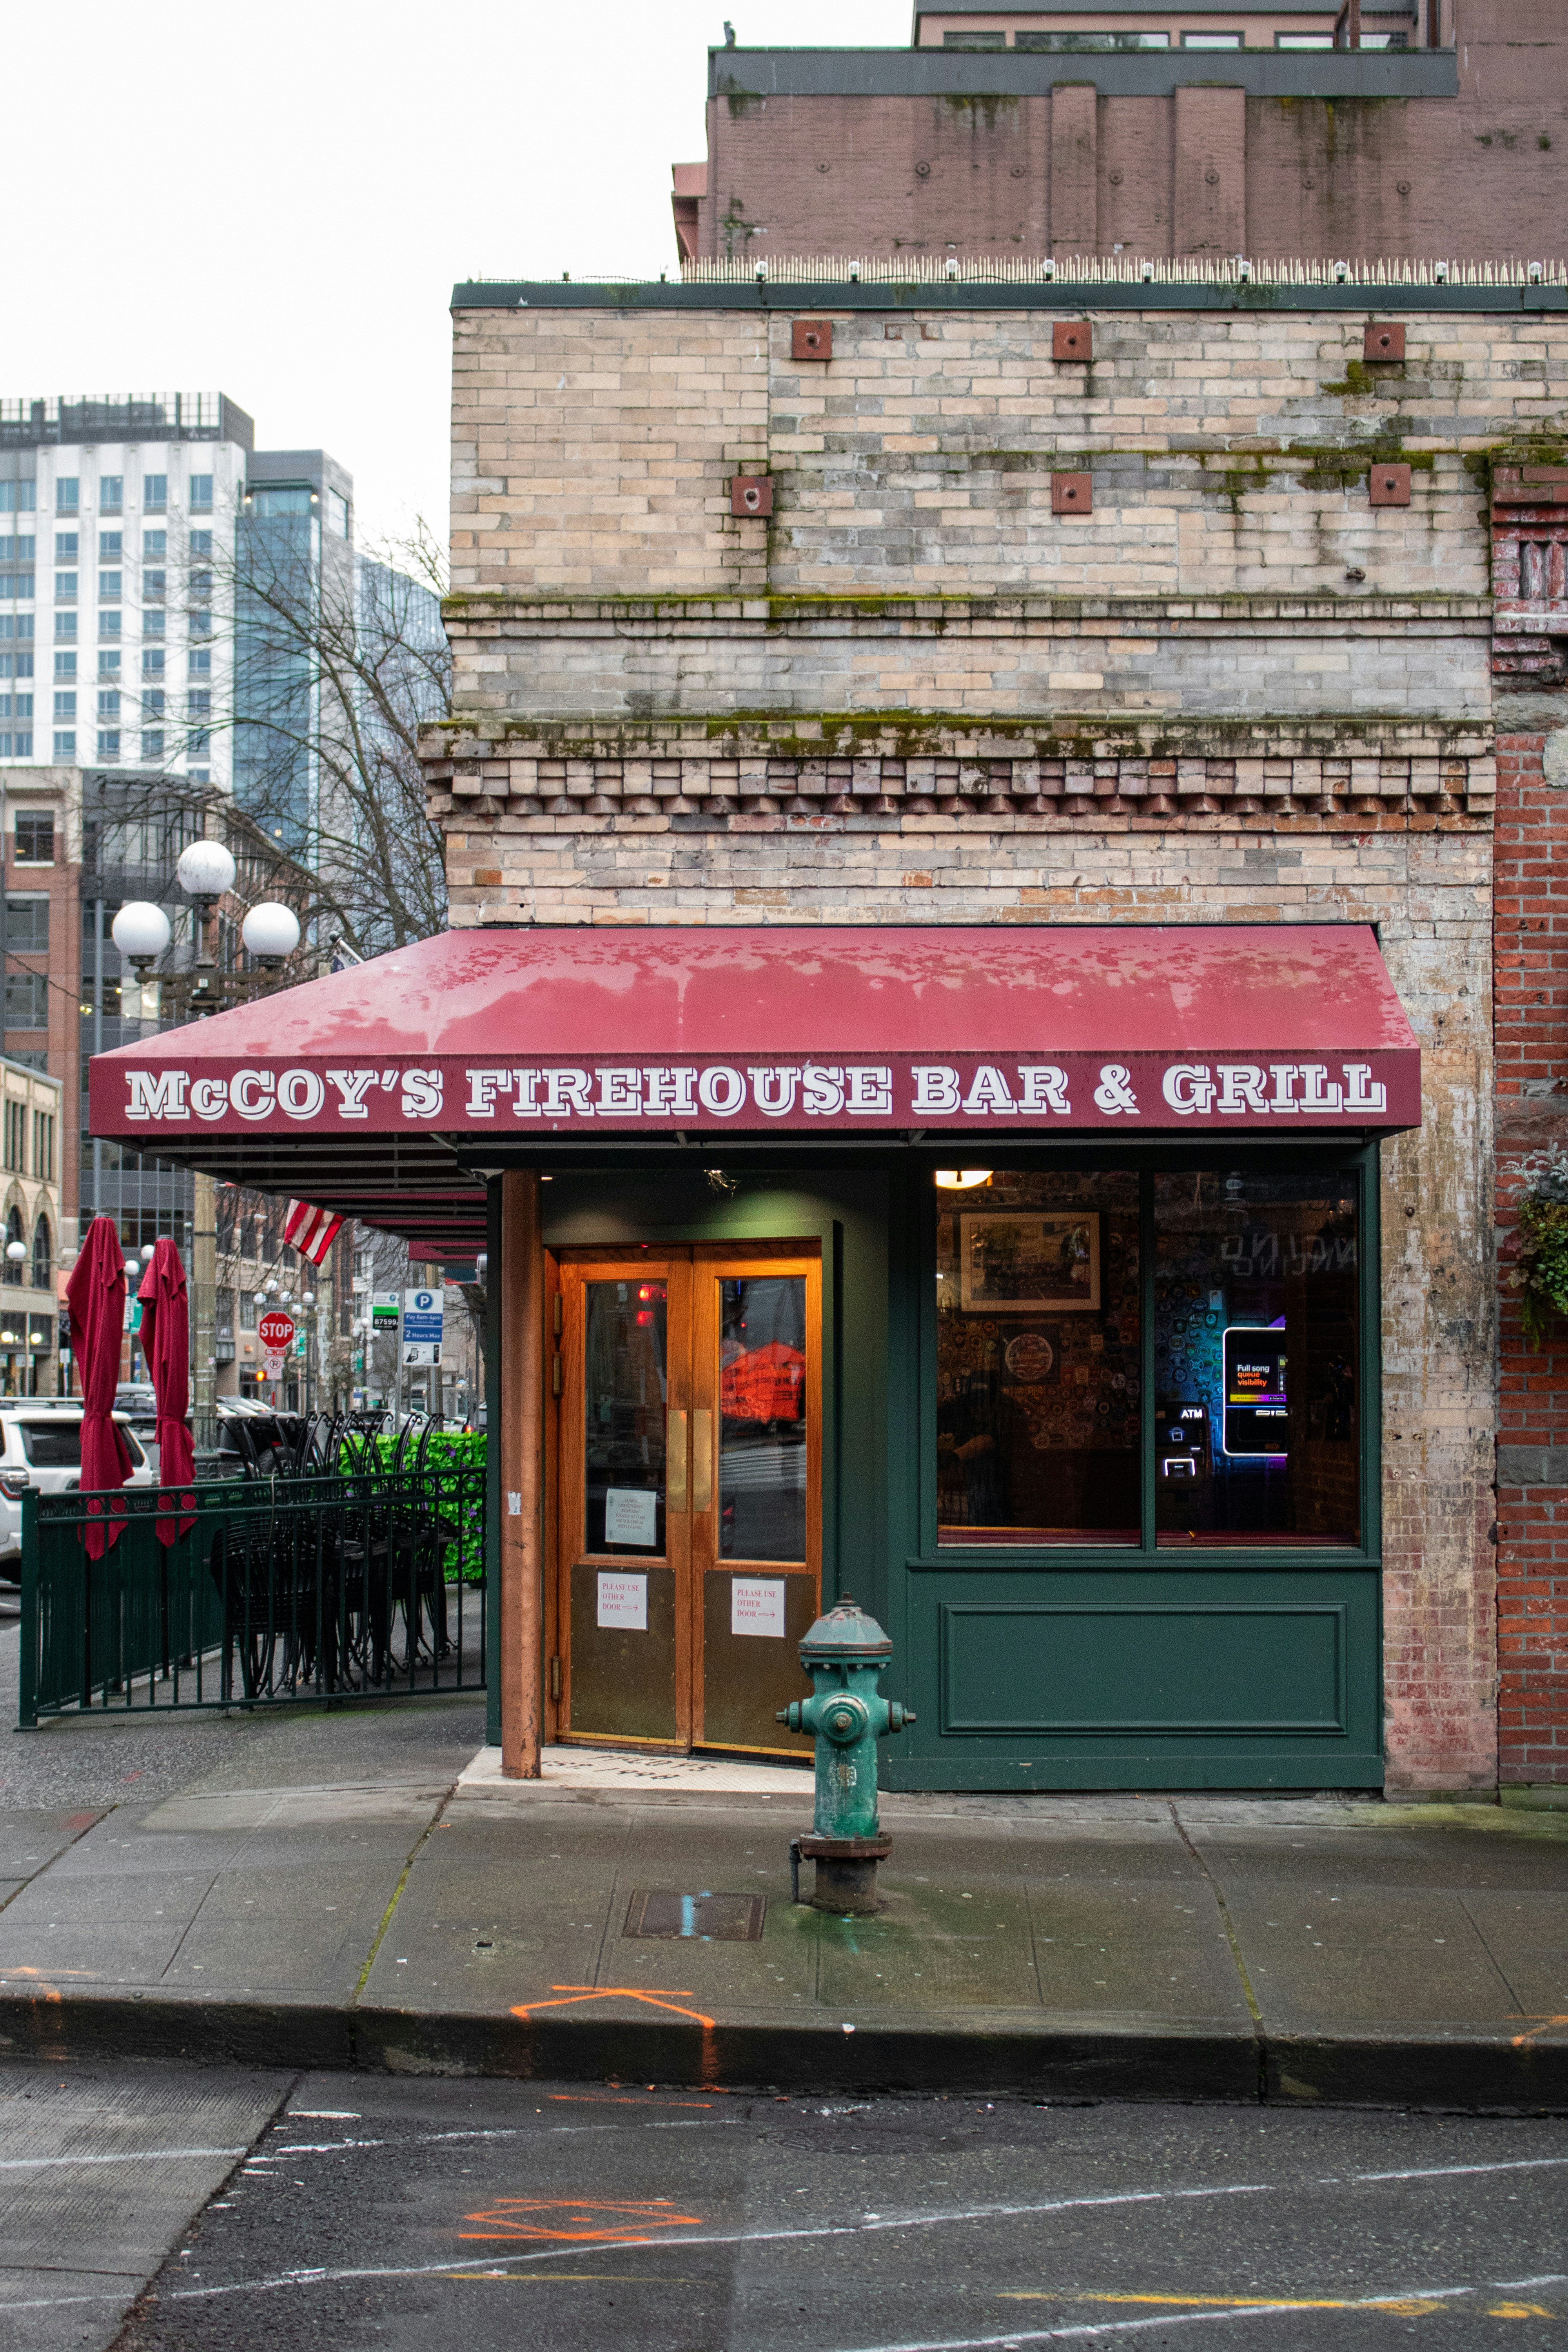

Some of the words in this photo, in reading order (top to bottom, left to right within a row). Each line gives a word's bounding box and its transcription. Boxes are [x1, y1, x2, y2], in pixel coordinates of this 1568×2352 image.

[125, 1069, 443, 1120] McCOY'S
[465, 1065, 892, 1117] FIREHOUSE
[911, 1064, 1071, 1115] BAR
[1094, 1064, 1140, 1114] &
[1162, 1064, 1387, 1114] GRILL
[421, 1296, 429, 1306] P
[261, 1323, 292, 1338] STOP
[1181, 1409, 1203, 1419] ATM
[737, 1589, 762, 1597] PLEASE
[737, 1609, 757, 1617] DOOR
